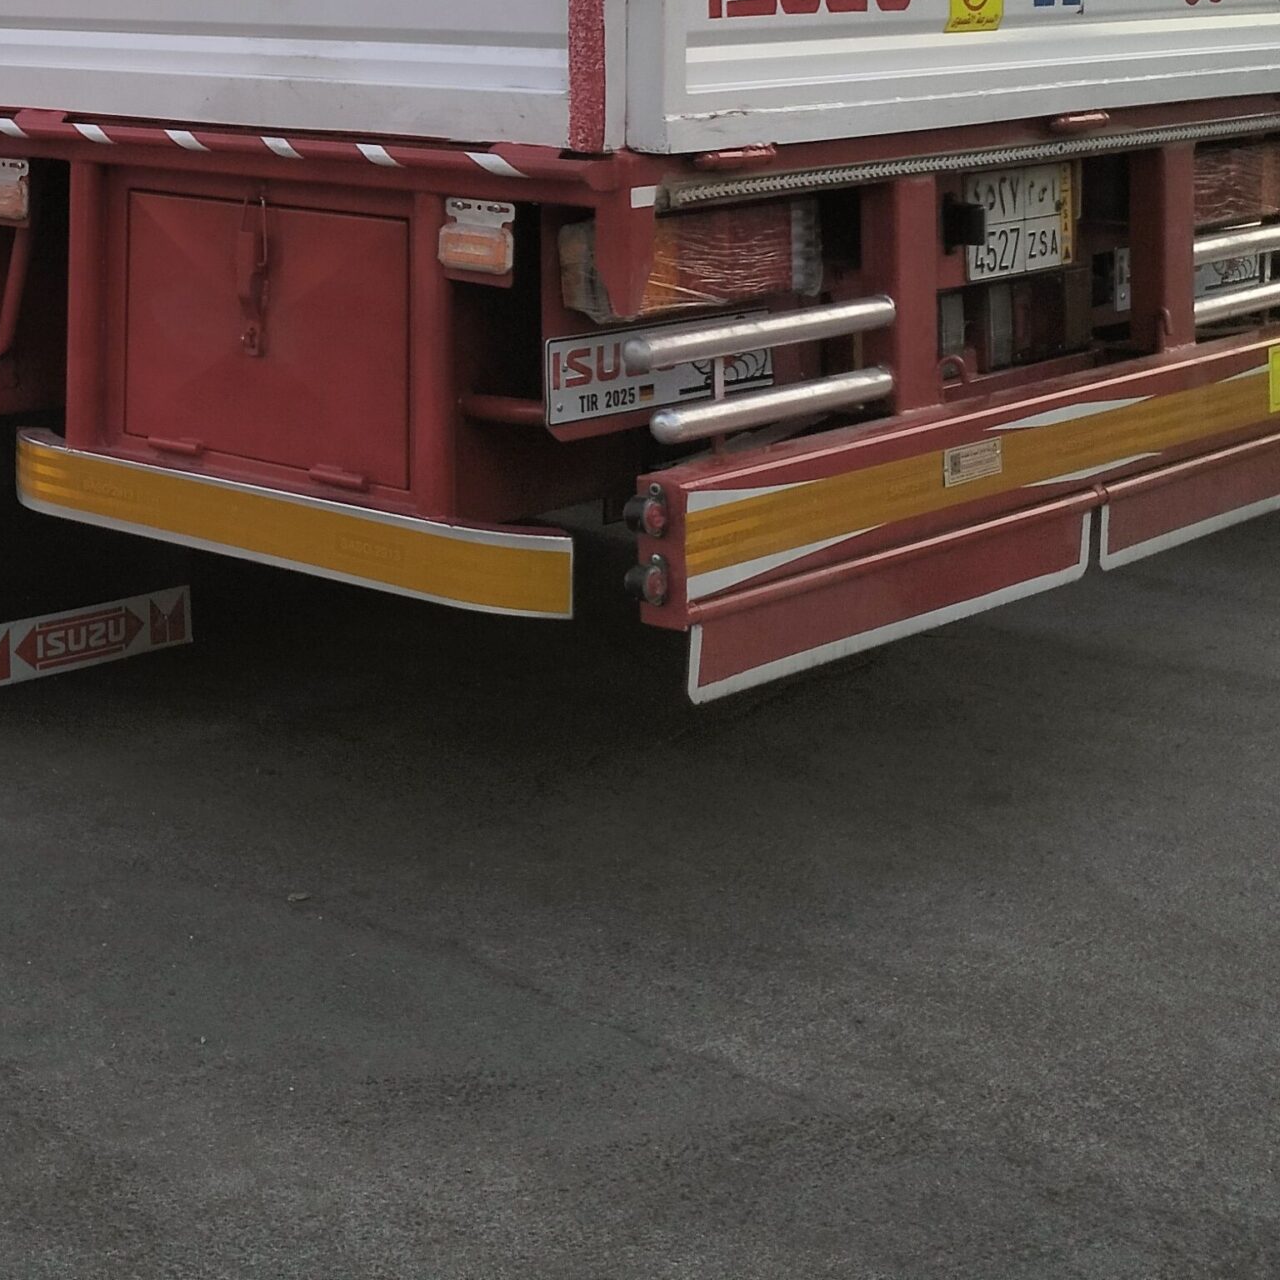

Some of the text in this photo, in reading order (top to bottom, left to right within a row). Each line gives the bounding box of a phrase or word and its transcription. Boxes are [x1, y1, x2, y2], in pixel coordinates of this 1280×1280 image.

[975, 228, 1058, 274] 4527 ZSA
[579, 387, 636, 413] TIR 2025
[36, 617, 126, 658] ISUZU
